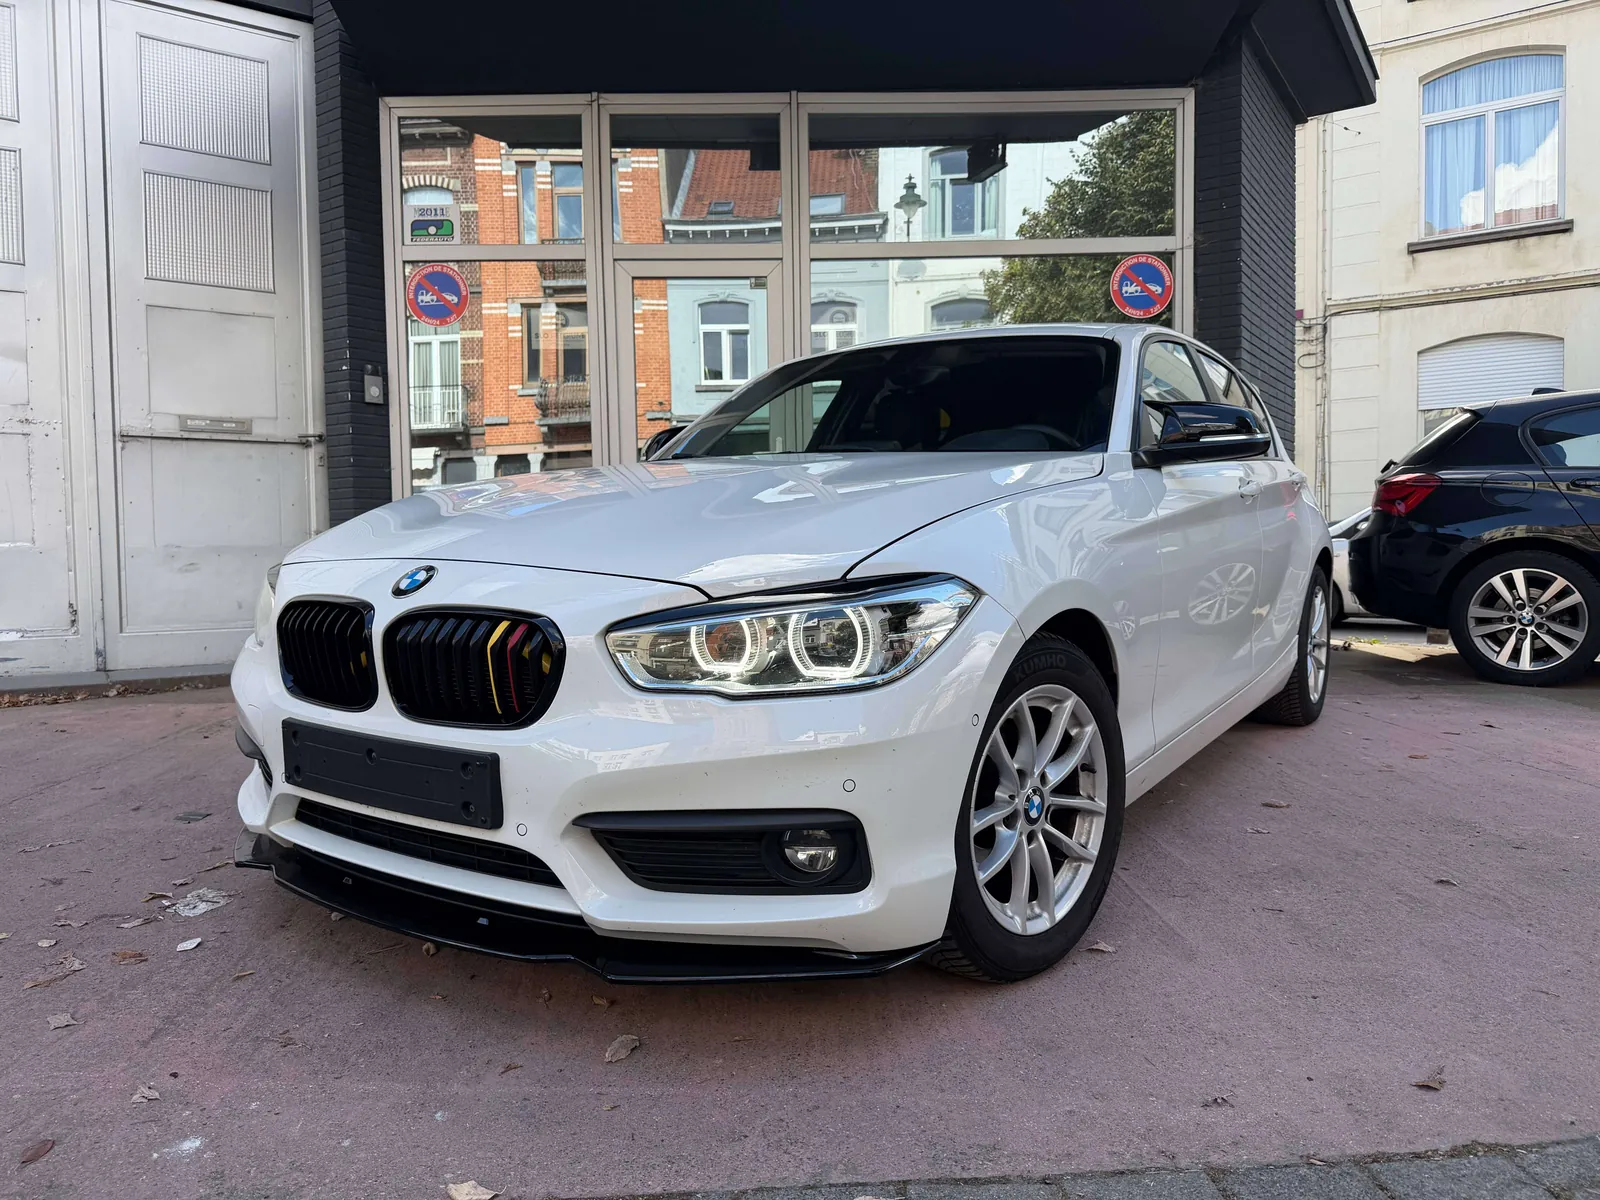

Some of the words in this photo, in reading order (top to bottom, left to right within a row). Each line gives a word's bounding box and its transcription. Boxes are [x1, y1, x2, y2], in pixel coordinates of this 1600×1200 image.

[419, 207, 446, 217] 2011
[409, 266, 433, 299] INTERDICTION
[442, 266, 467, 296] STATIONNER
[1113, 258, 1138, 290] INTERDICTION
[1147, 257, 1171, 286] STATIONNER
[1013, 653, 1067, 682] KUMHO
